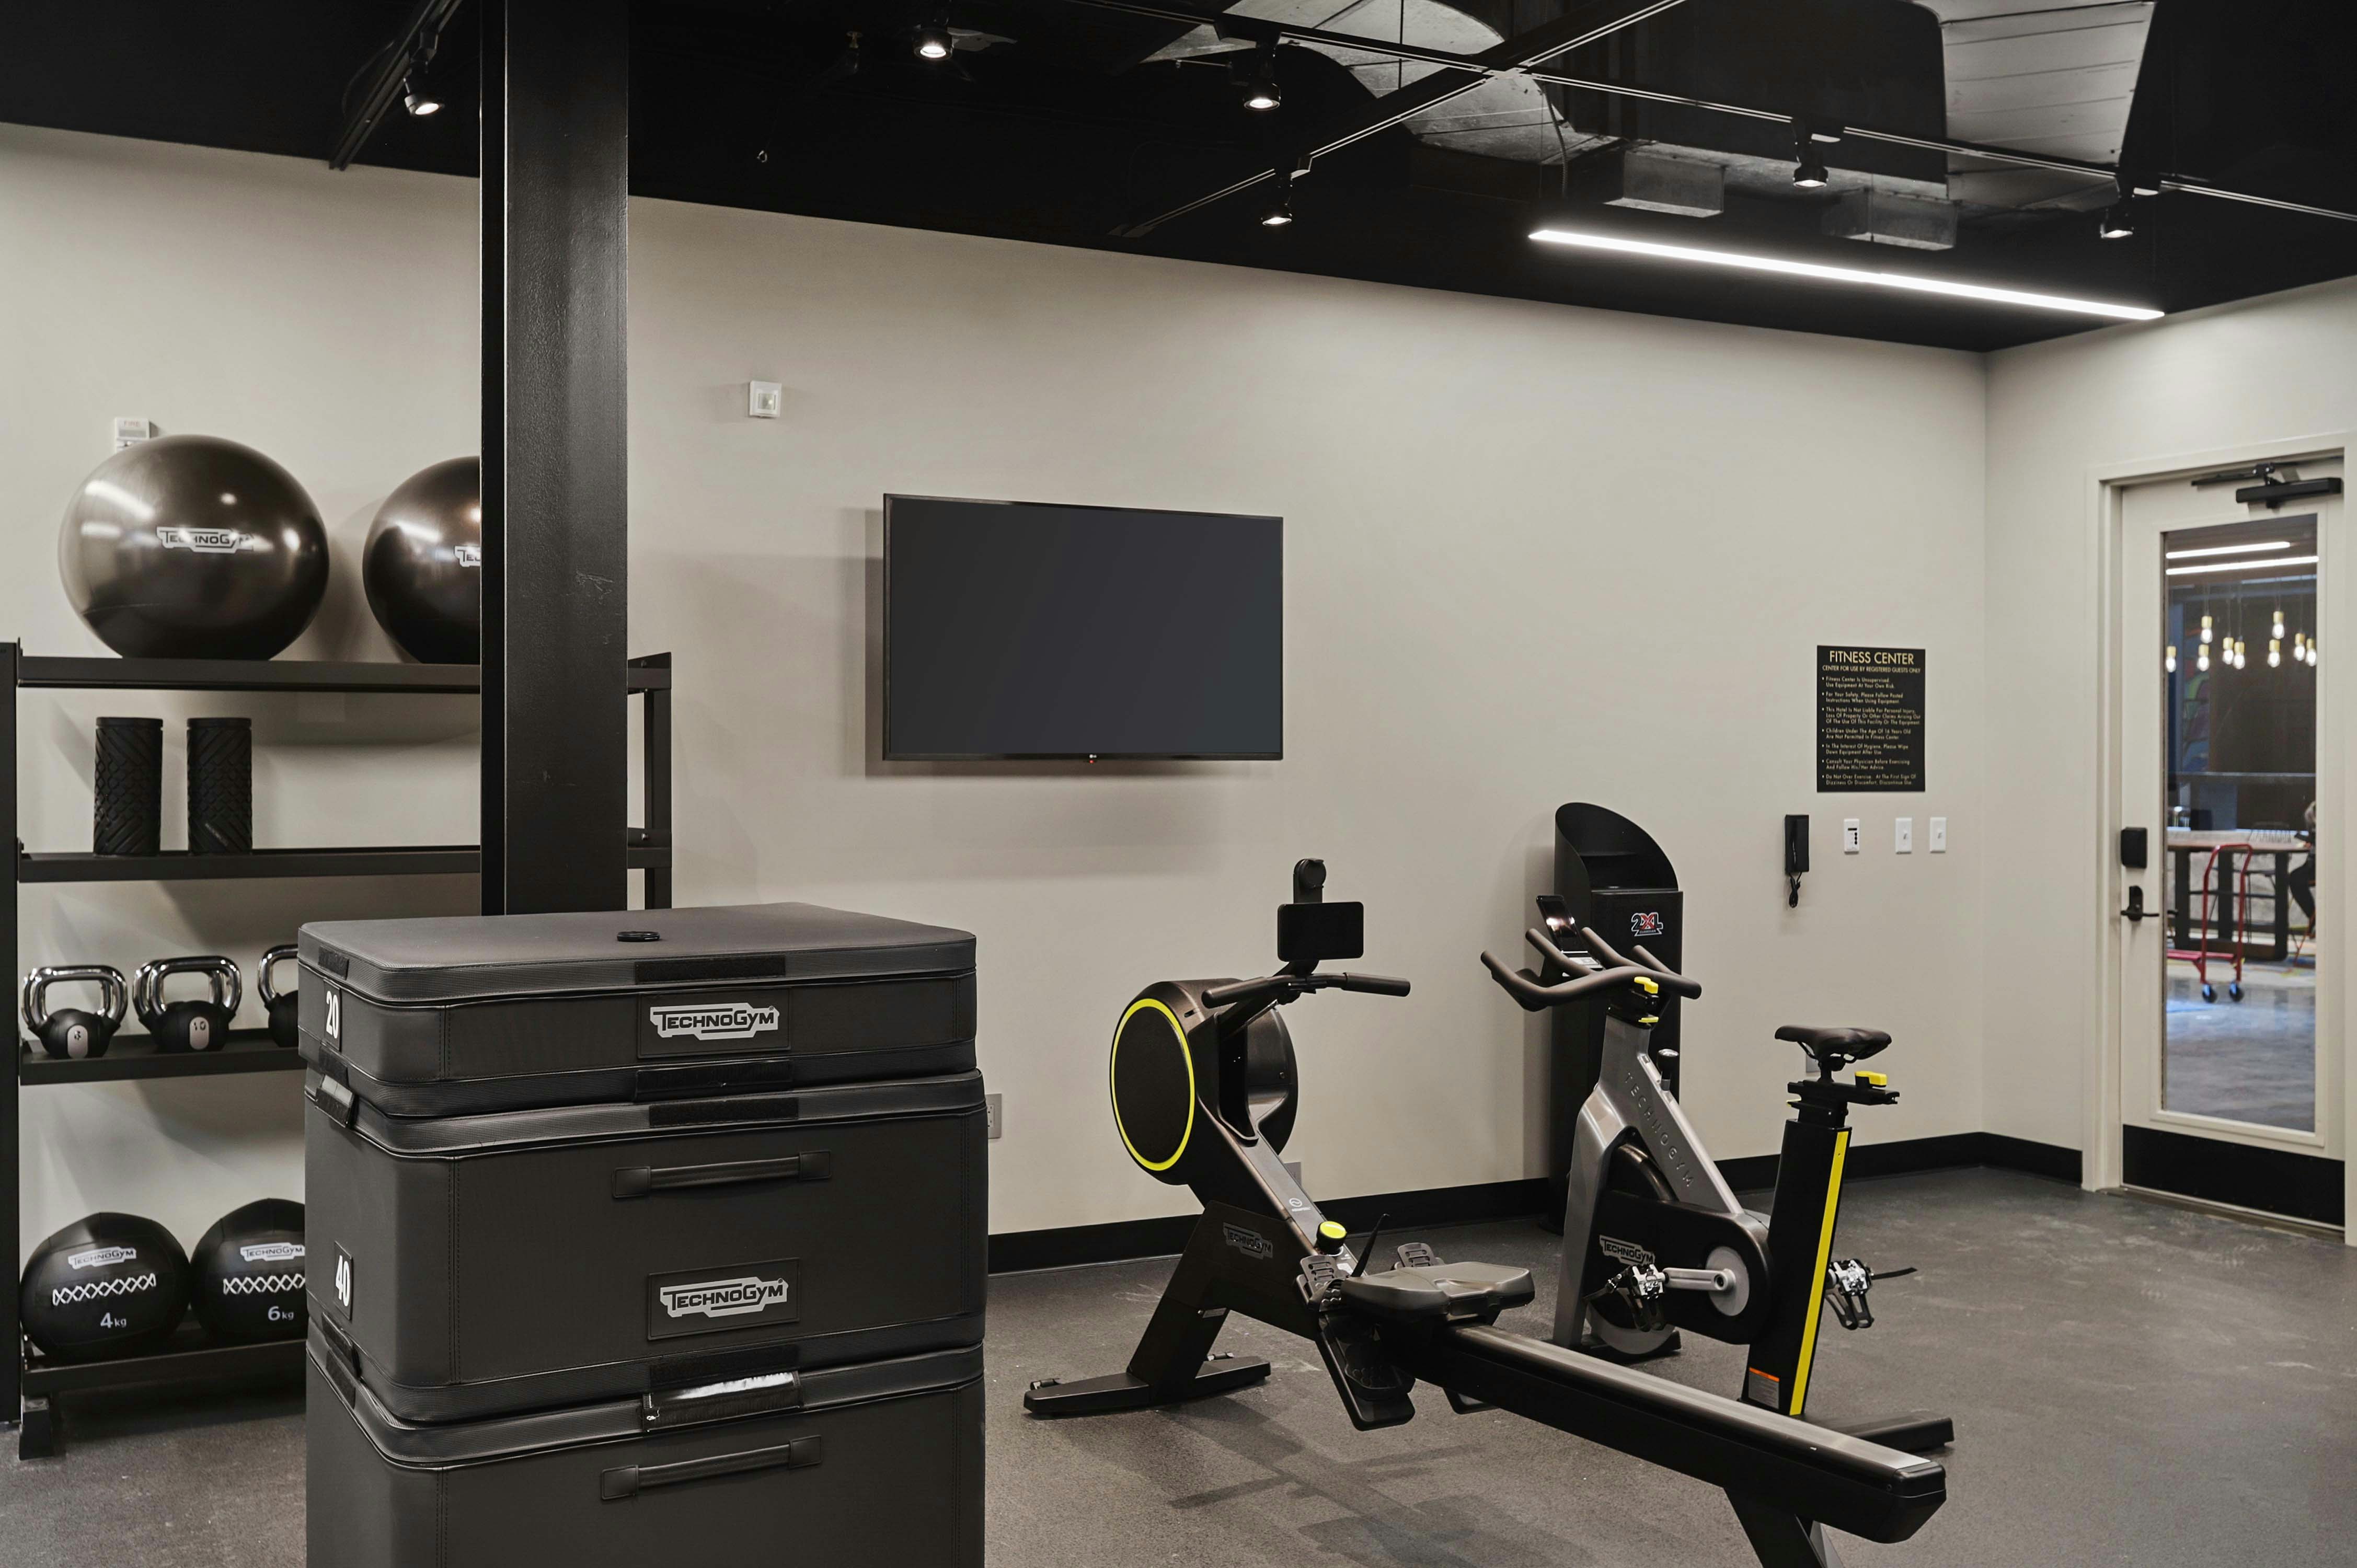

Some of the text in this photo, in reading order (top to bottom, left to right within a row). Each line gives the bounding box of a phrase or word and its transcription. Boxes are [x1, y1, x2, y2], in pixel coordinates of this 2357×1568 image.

[1830, 650, 1914, 665] FITNESS CENTER
[1631, 912, 1663, 931] 2XL
[192, 1021, 206, 1031] 10
[326, 990, 339, 1039] 20
[653, 1008, 774, 1034] TECHNOGYM
[1624, 1072, 1694, 1187] TECHNOGYM
[242, 1246, 303, 1258] TECHNOGYM
[1224, 1226, 1272, 1253] TECHNOGYM
[1600, 1237, 1653, 1264] TECHNOGYM
[71, 1250, 134, 1266] TECHNOGYM
[335, 1254, 350, 1307] 40
[662, 1283, 783, 1311] TECHNOGYM
